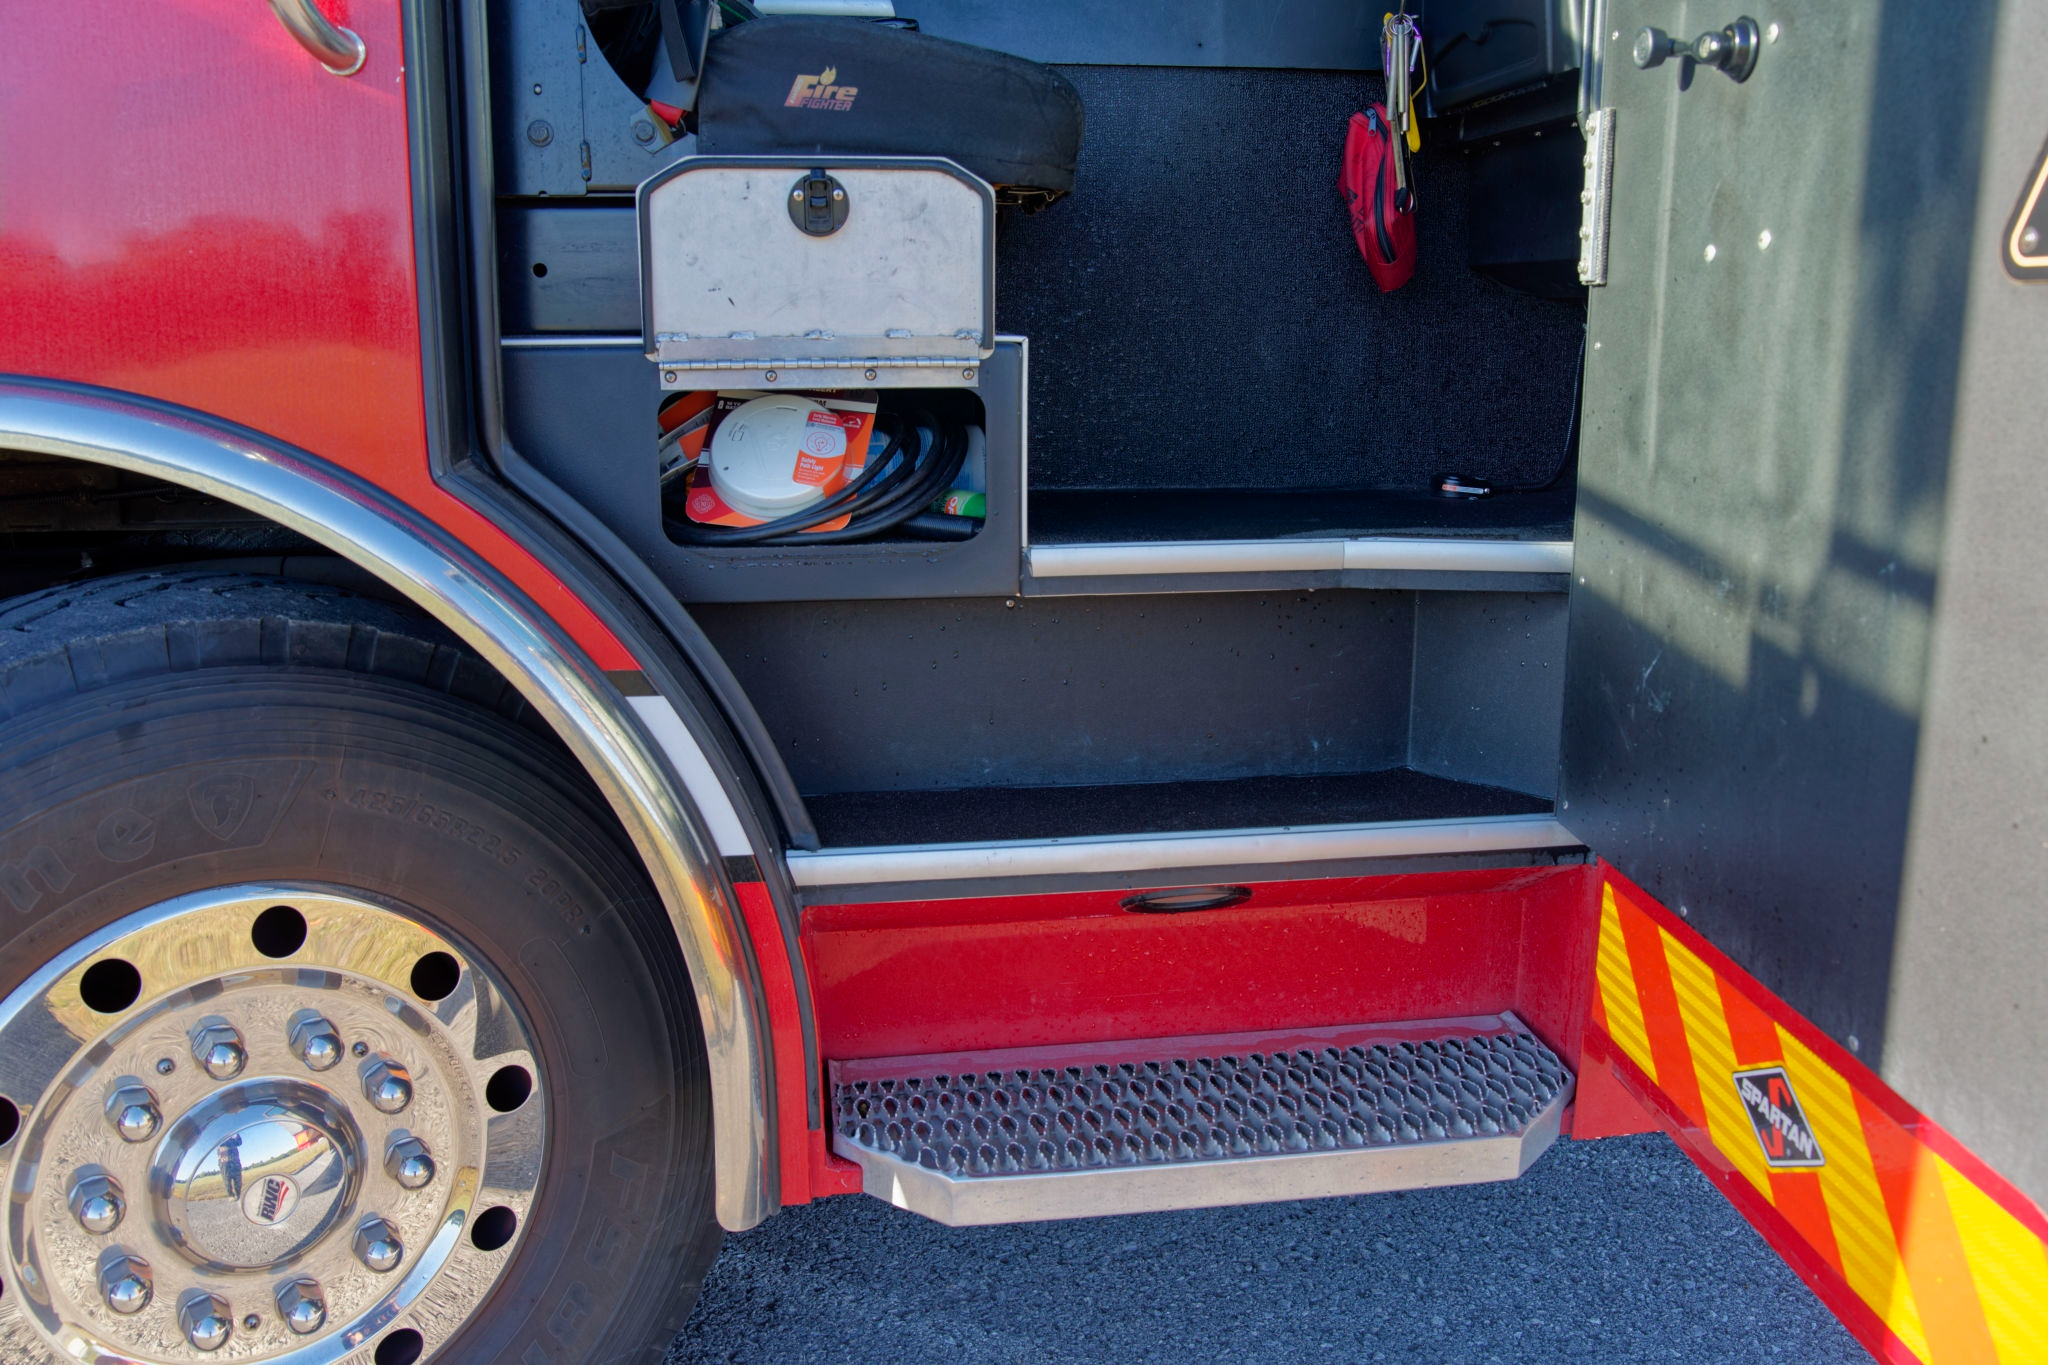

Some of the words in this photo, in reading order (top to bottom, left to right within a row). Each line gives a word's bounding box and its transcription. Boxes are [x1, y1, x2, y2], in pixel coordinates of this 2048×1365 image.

[784, 66, 858, 107] Fire
[800, 98, 852, 111] FIGHTER
[1741, 1078, 1813, 1159] SPARTAN
